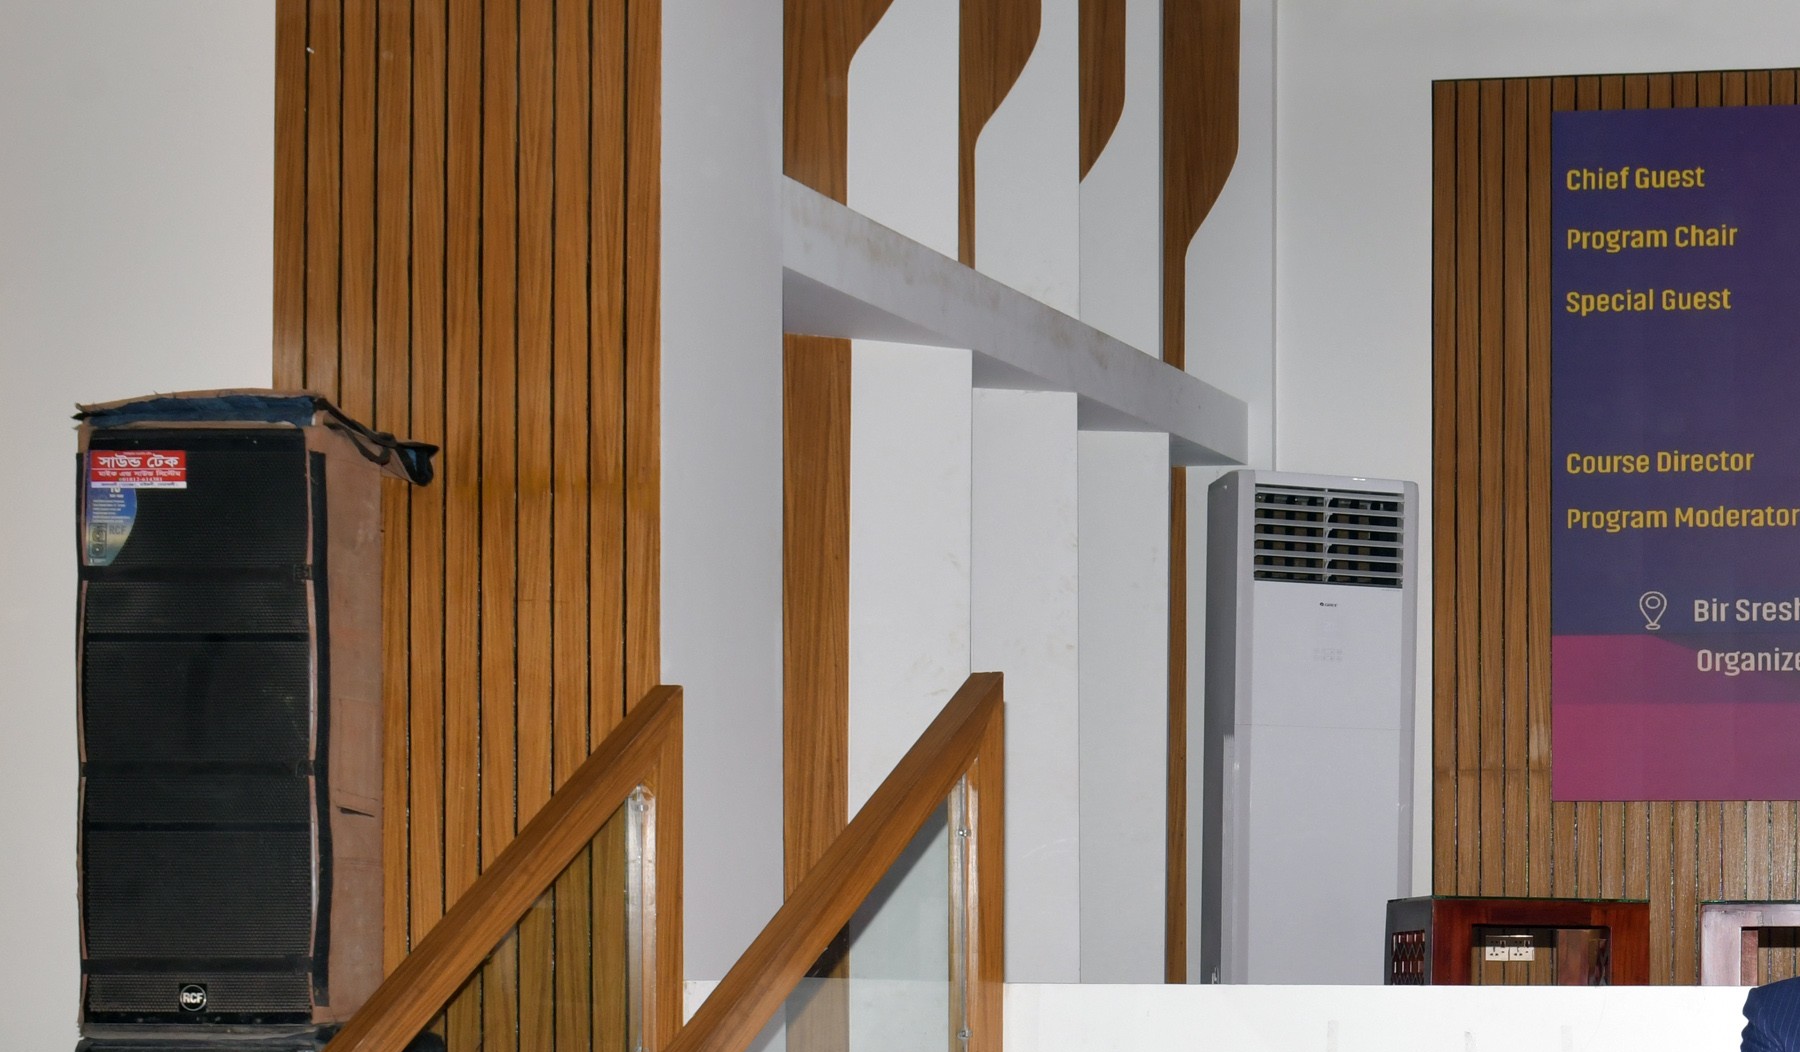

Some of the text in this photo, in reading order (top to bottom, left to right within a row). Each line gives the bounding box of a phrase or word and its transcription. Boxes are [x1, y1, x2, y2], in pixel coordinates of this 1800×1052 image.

[1566, 166, 1705, 191] Chief Guest
[1567, 224, 1738, 254] Program Chair
[1566, 288, 1731, 317] Special Guest
[97, 453, 180, 468] সাউন্ড টেক
[1566, 450, 1754, 475] Course Director
[1567, 505, 1800, 534] Program Moderator
[1694, 598, 1730, 622] Bir
[182, 992, 204, 1004] RCF
